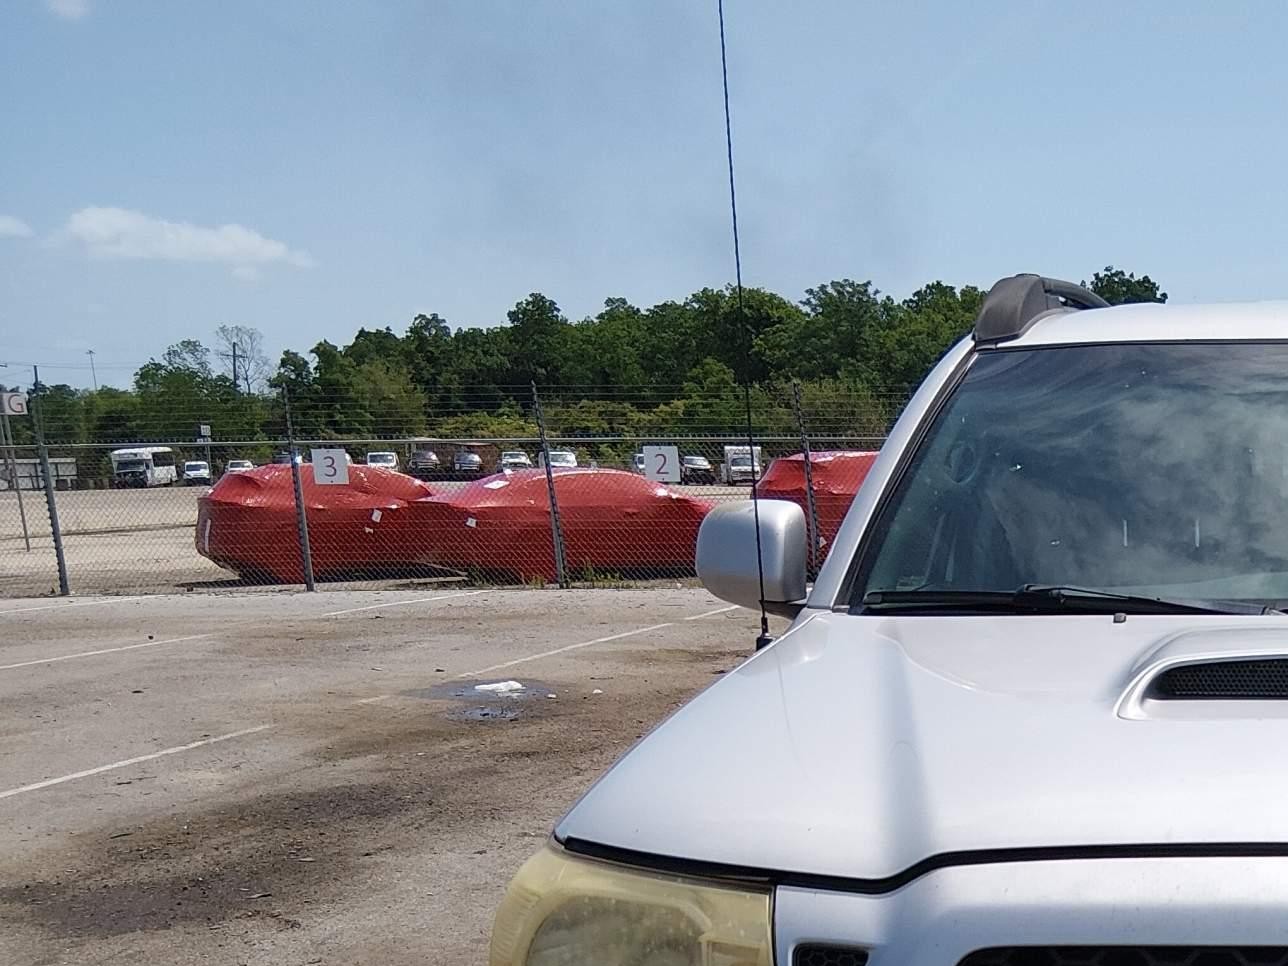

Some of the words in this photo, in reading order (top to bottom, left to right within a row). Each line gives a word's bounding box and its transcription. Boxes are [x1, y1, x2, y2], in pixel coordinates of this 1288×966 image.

[8, 394, 24, 413] G
[323, 456, 337, 477] 3
[655, 453, 669, 474] 2
